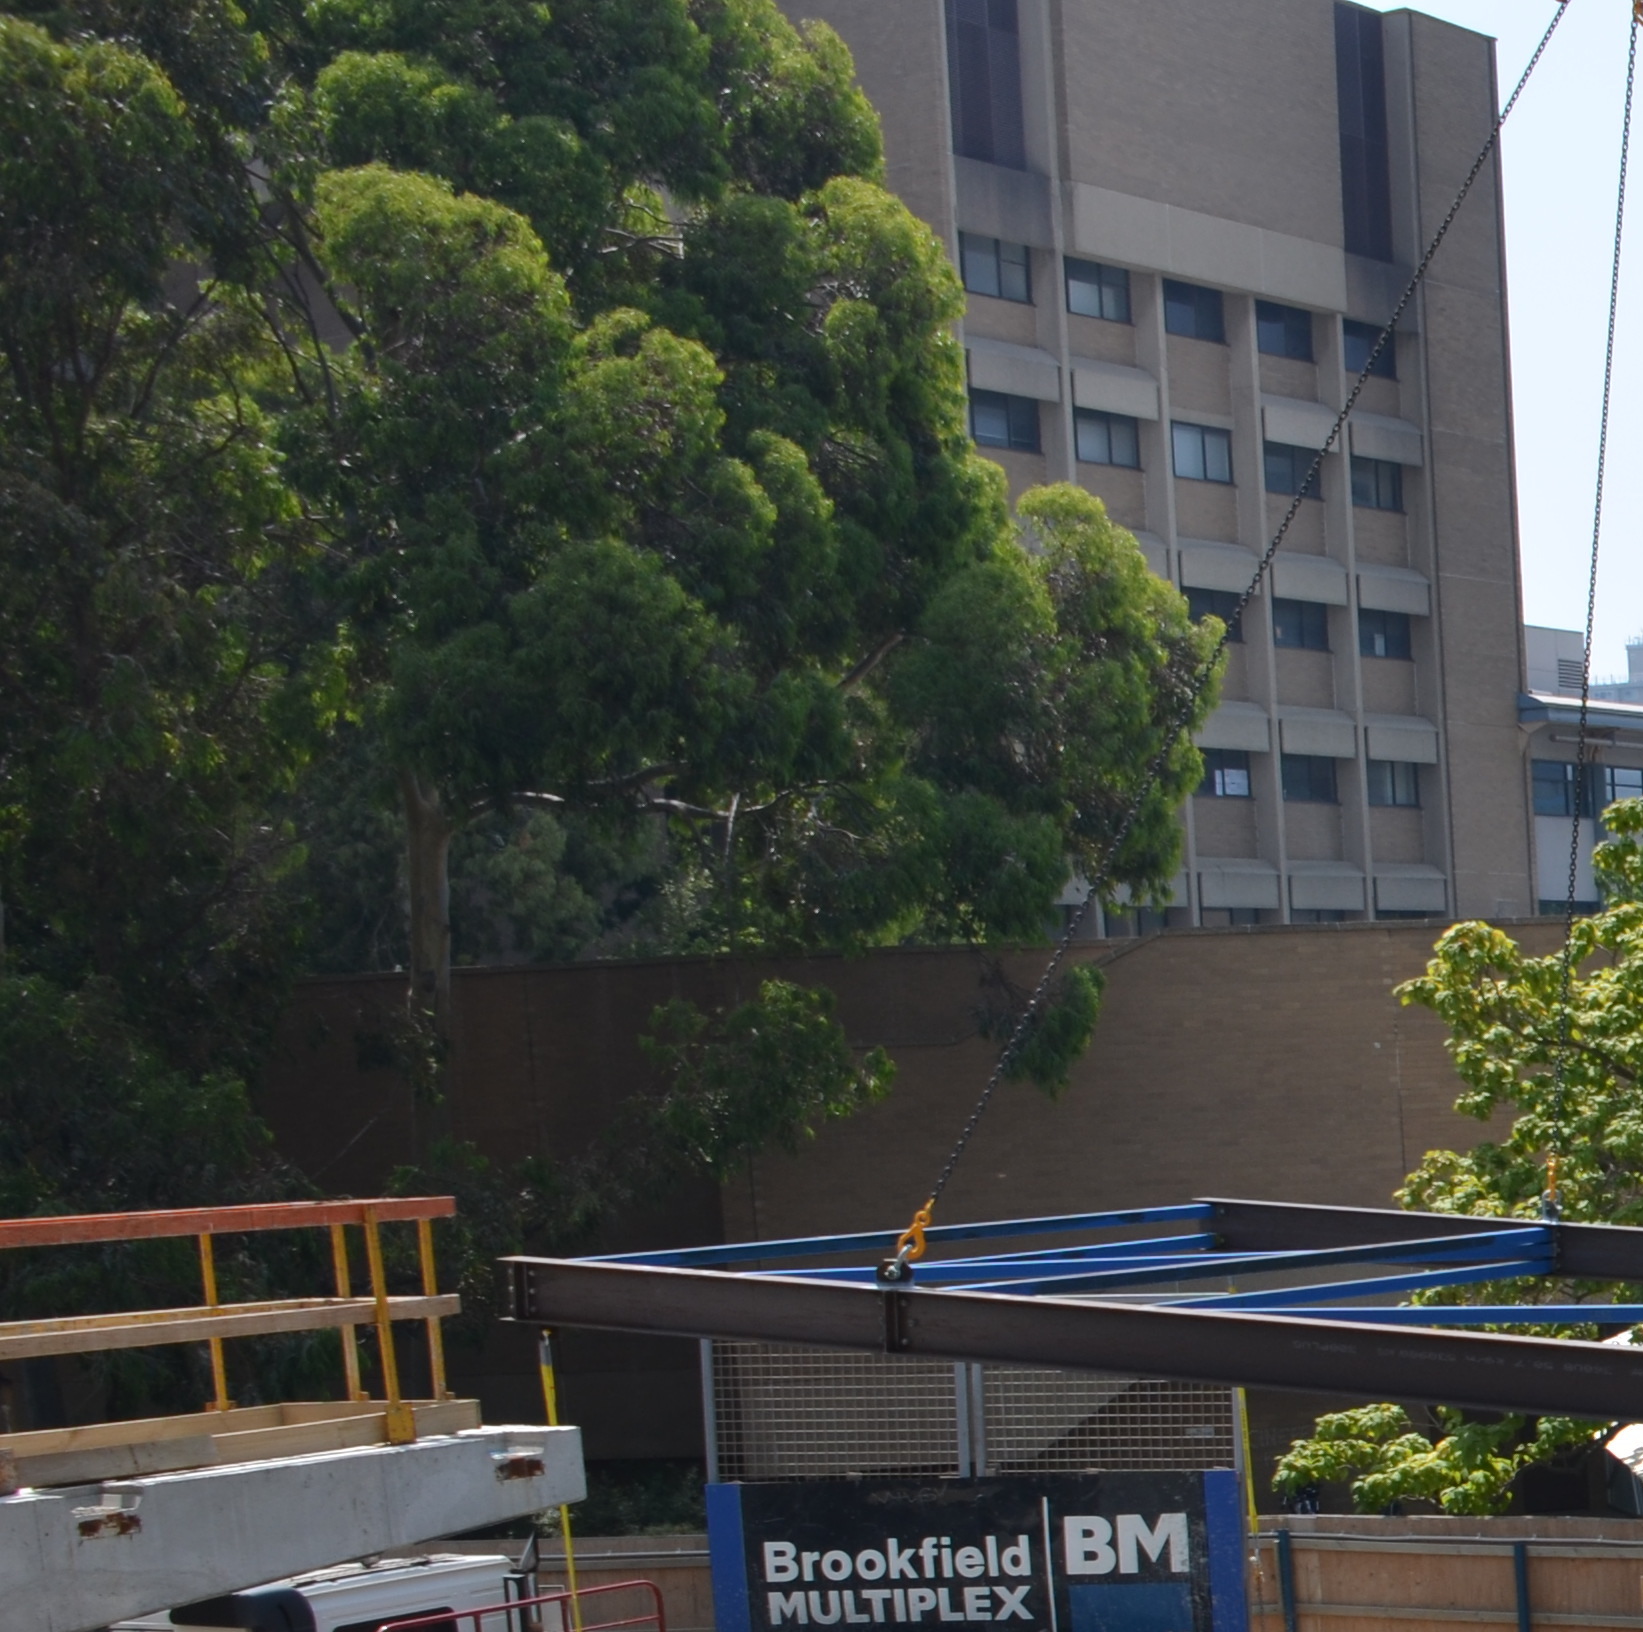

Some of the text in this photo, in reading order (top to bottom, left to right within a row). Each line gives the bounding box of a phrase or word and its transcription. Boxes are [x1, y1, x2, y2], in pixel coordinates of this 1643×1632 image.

[763, 1512, 1190, 1584] Brookfield BM
[767, 1584, 1034, 1626] MULTIPLEX
